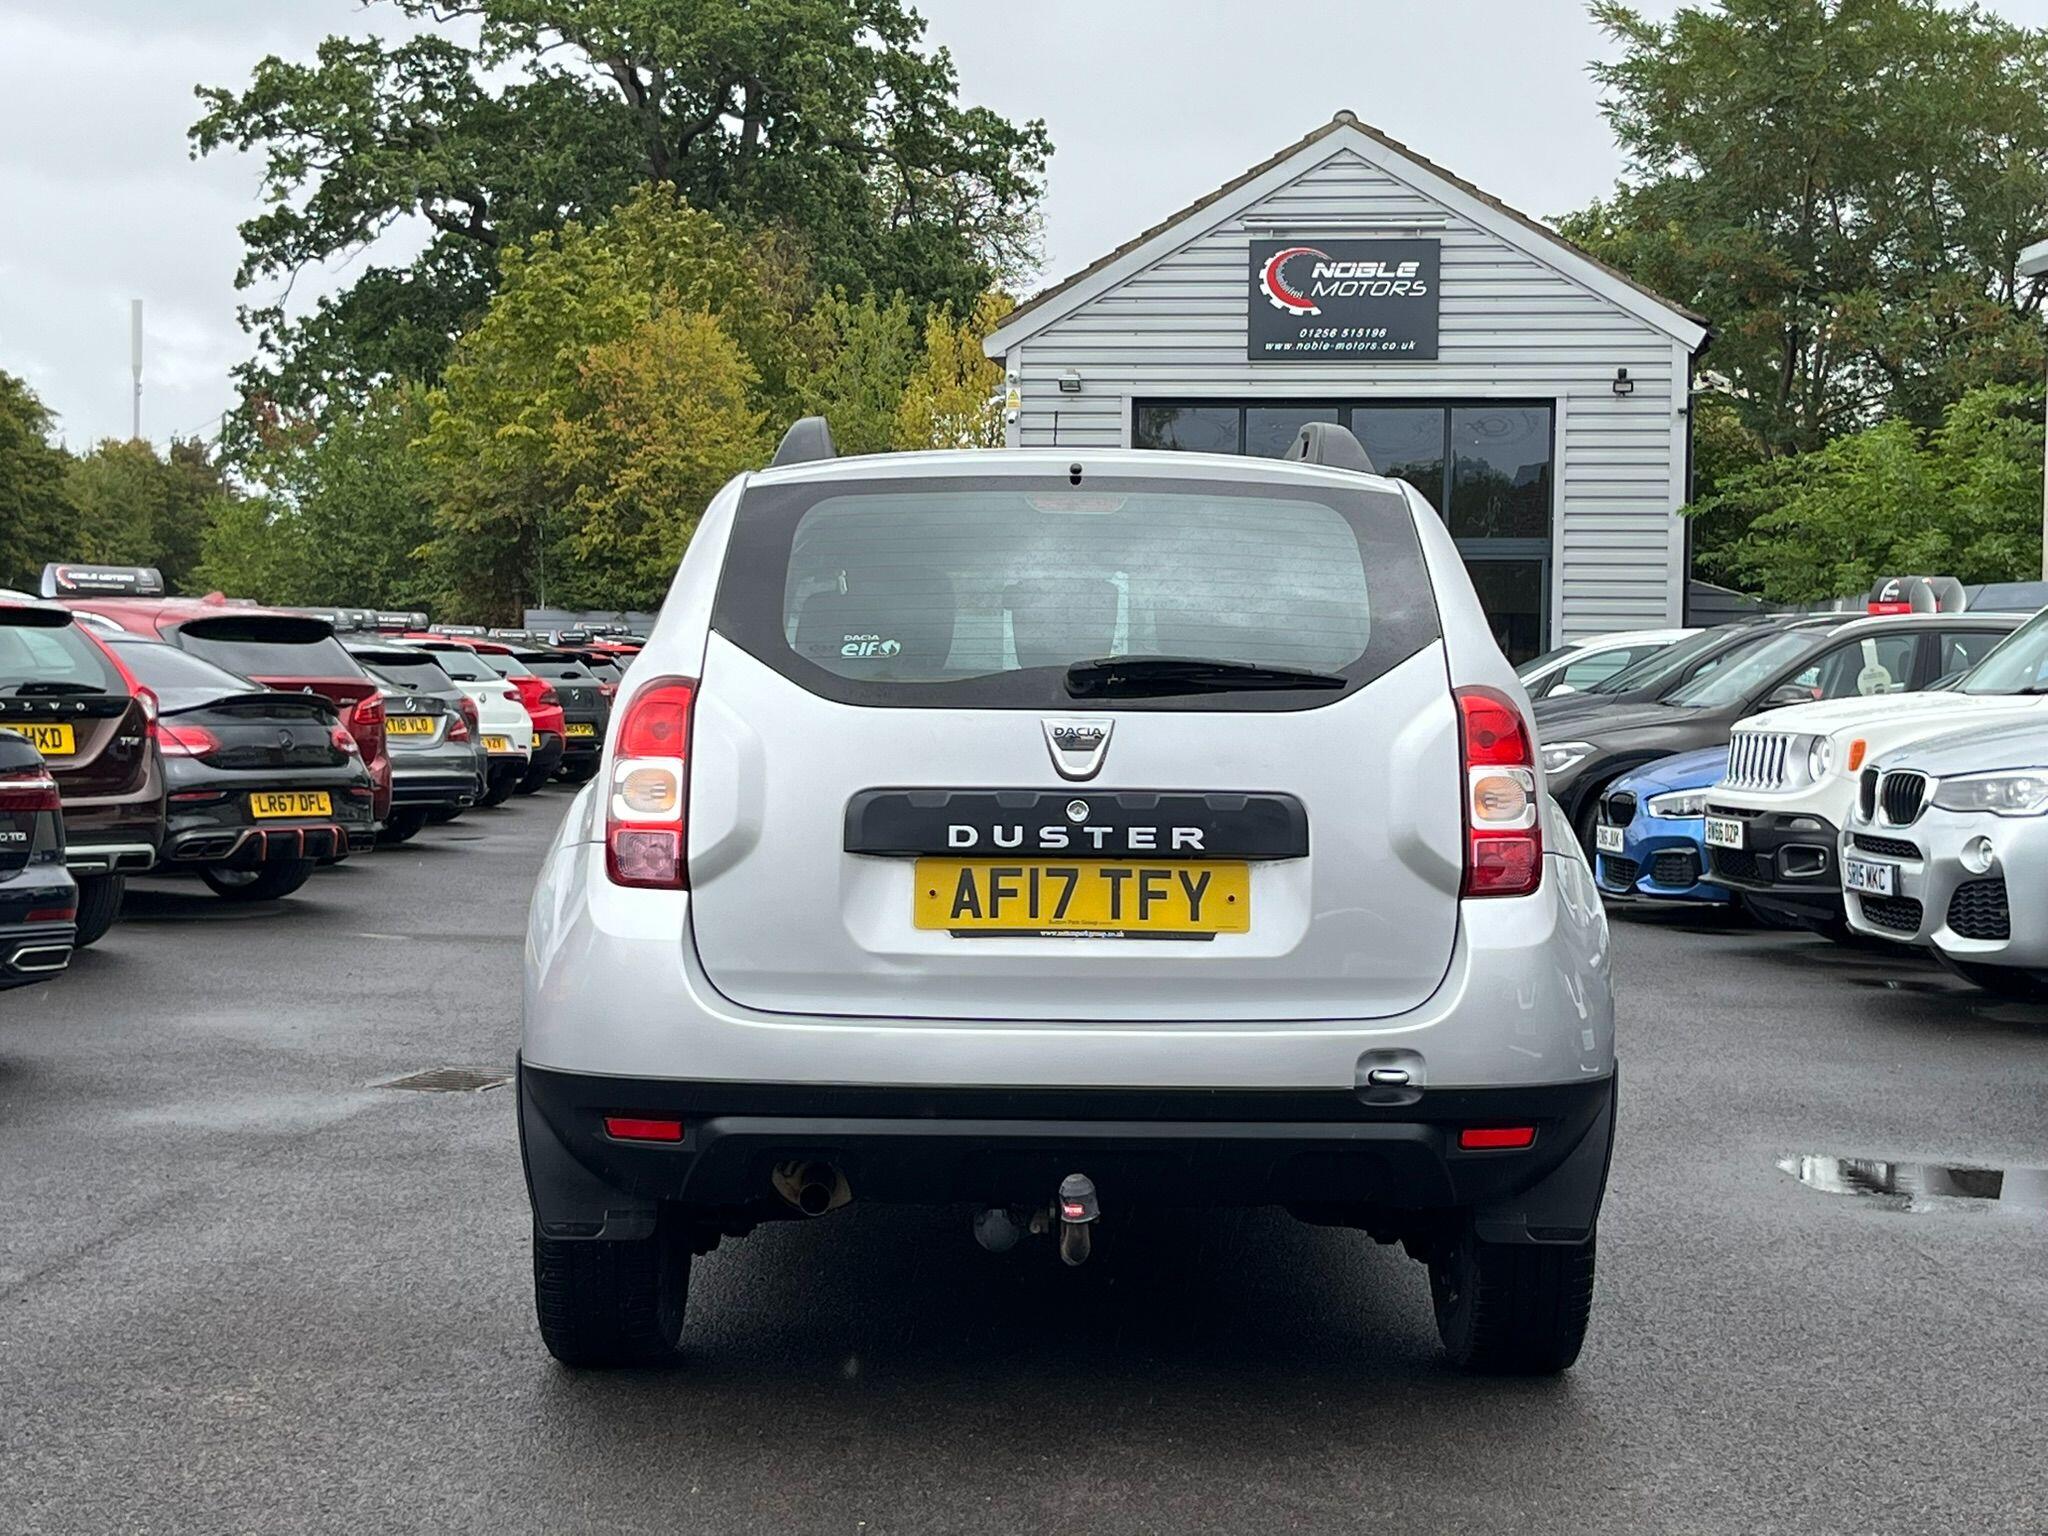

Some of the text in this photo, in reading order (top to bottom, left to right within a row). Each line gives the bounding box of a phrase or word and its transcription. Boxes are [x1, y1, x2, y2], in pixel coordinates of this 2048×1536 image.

[1311, 262, 1420, 278] NOBLE
[1311, 280, 1427, 297] MOTORS
[1300, 328, 1387, 338] 01256 515196
[1265, 340, 1416, 351] www.noble-motors.co.uk
[841, 642, 879, 656] elf
[1054, 727, 1105, 738] DACIA
[257, 794, 325, 813] LR67 DFL
[948, 825, 1205, 850] DUSTER
[950, 867, 1211, 921] AF17 TFY
